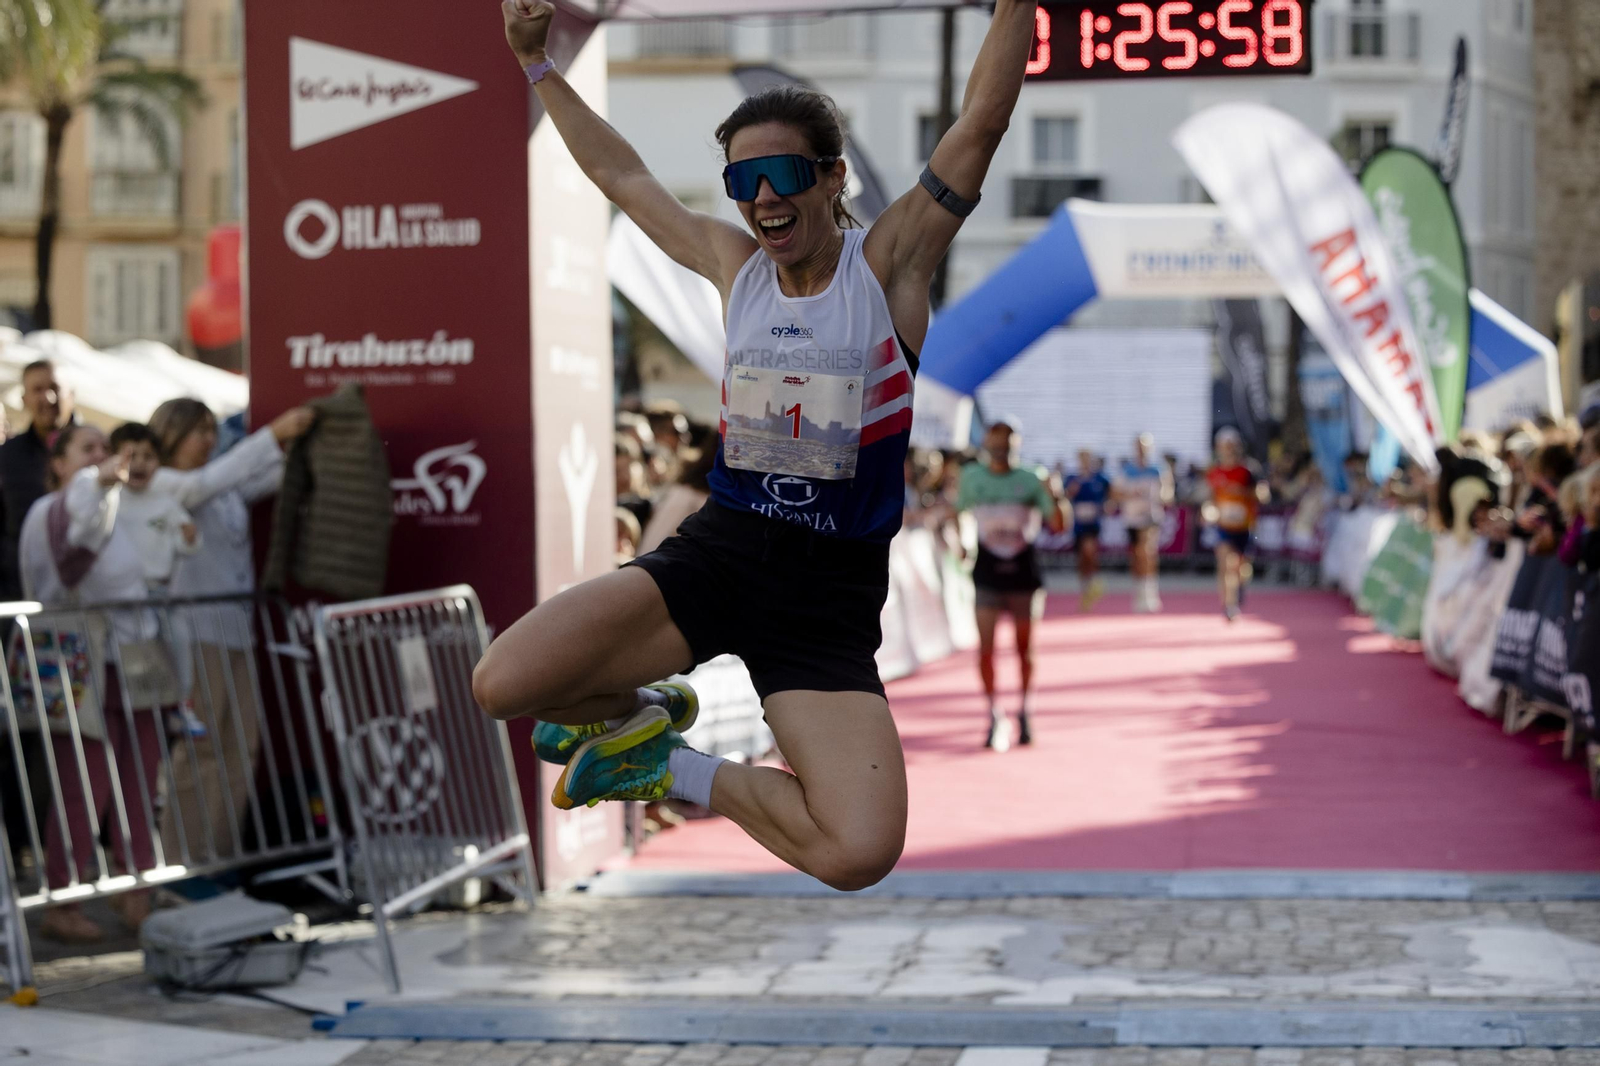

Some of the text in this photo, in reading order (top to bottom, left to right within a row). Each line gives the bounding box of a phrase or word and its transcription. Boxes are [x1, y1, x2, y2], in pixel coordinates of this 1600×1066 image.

[342, 204, 399, 250] HLA
[400, 217, 481, 248] LA SALUD
[286, 330, 474, 368] Tirabuzón
[785, 402, 802, 440] 1
